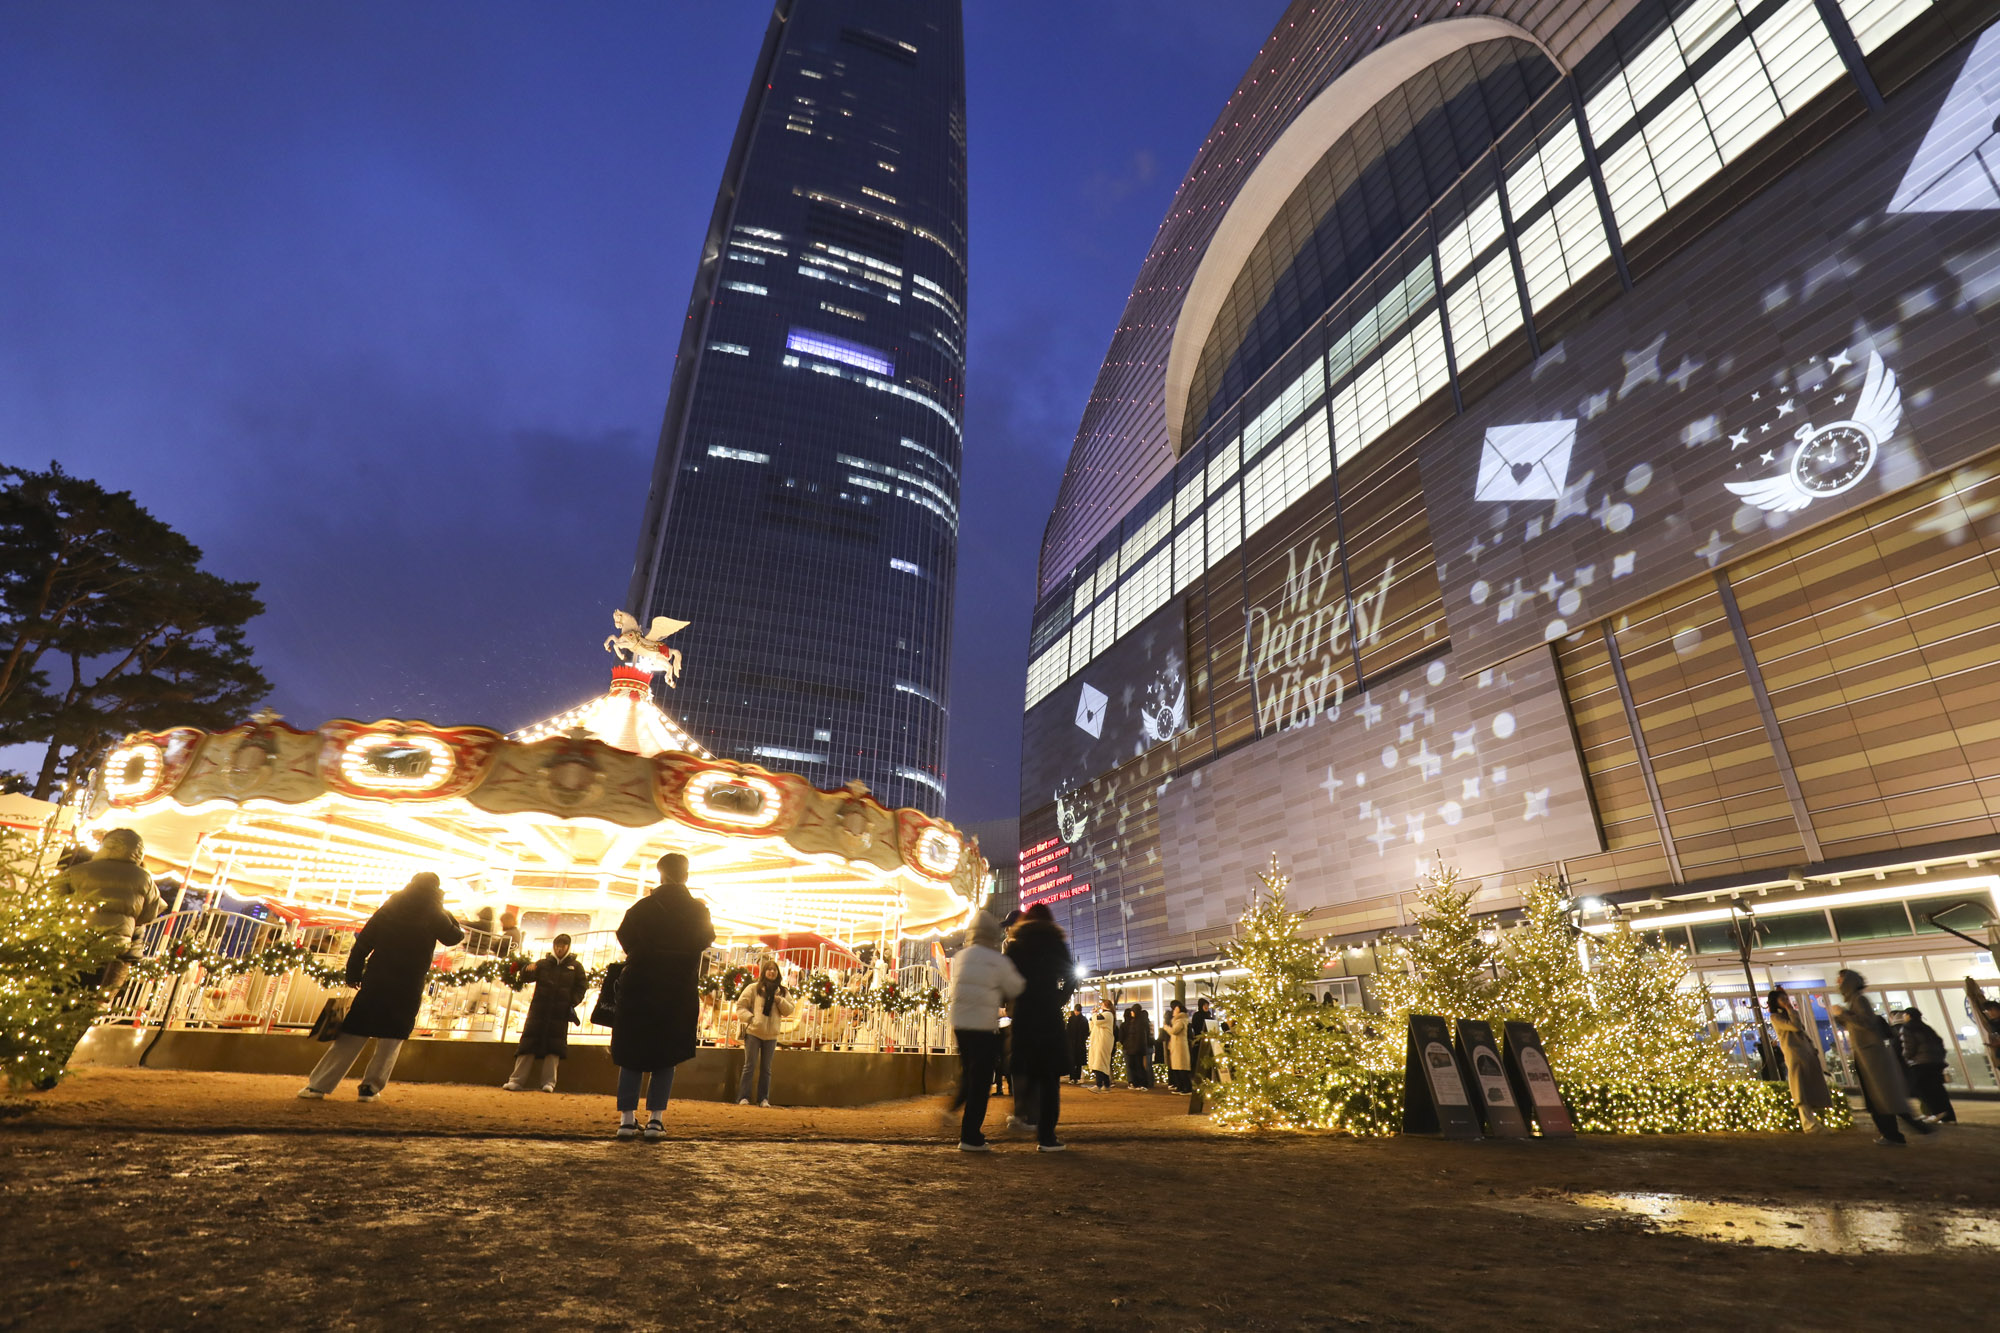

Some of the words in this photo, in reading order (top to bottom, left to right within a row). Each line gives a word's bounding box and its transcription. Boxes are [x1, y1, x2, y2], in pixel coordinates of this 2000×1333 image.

[1235, 557, 1396, 684] Dearest
[1253, 653, 1345, 738] Wish
[1023, 848, 1037, 858] LOTTE
[1037, 841, 1048, 852] Mart
[1023, 860, 1037, 871] LOTTE
[1037, 853, 1055, 866] CINEMA
[1024, 870, 1045, 884] AQUARIUM
[1024, 887, 1038, 897] LOTTE
[1037, 879, 1056, 893] HIMART
[1038, 893, 1059, 905] CONCERT
[1059, 890, 1071, 900] HALL
